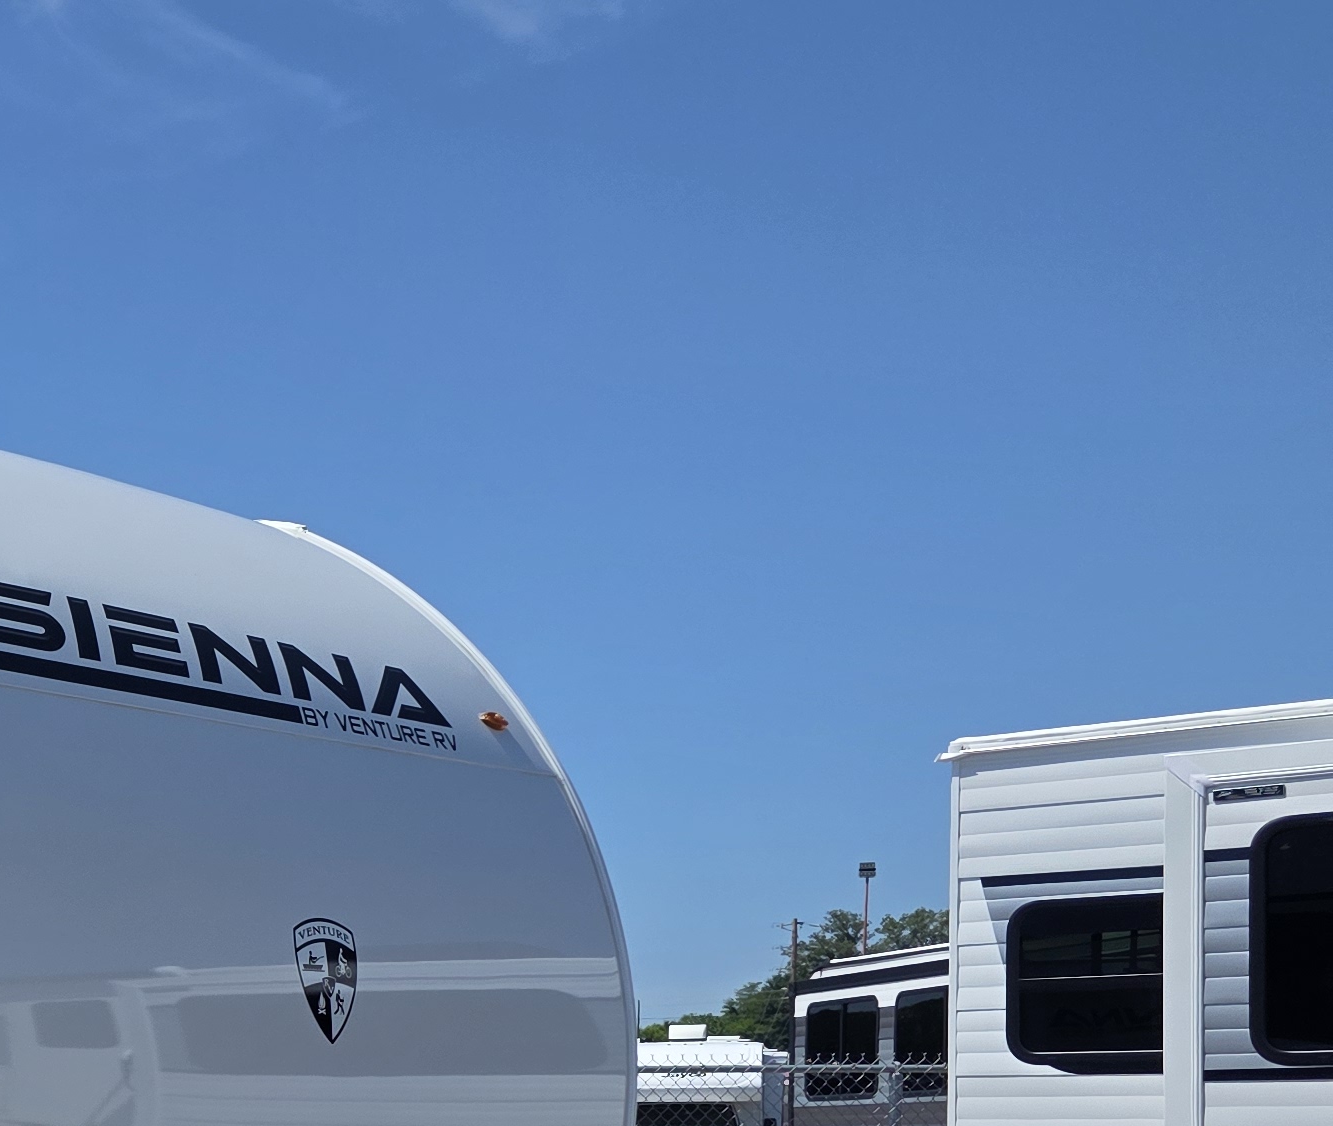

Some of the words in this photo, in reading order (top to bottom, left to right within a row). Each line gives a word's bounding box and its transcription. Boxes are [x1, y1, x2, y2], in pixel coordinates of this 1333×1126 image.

[301, 706, 329, 729] BY
[333, 712, 431, 747] VENTURE
[431, 730, 457, 752] RV
[297, 925, 351, 945] VENTURE
